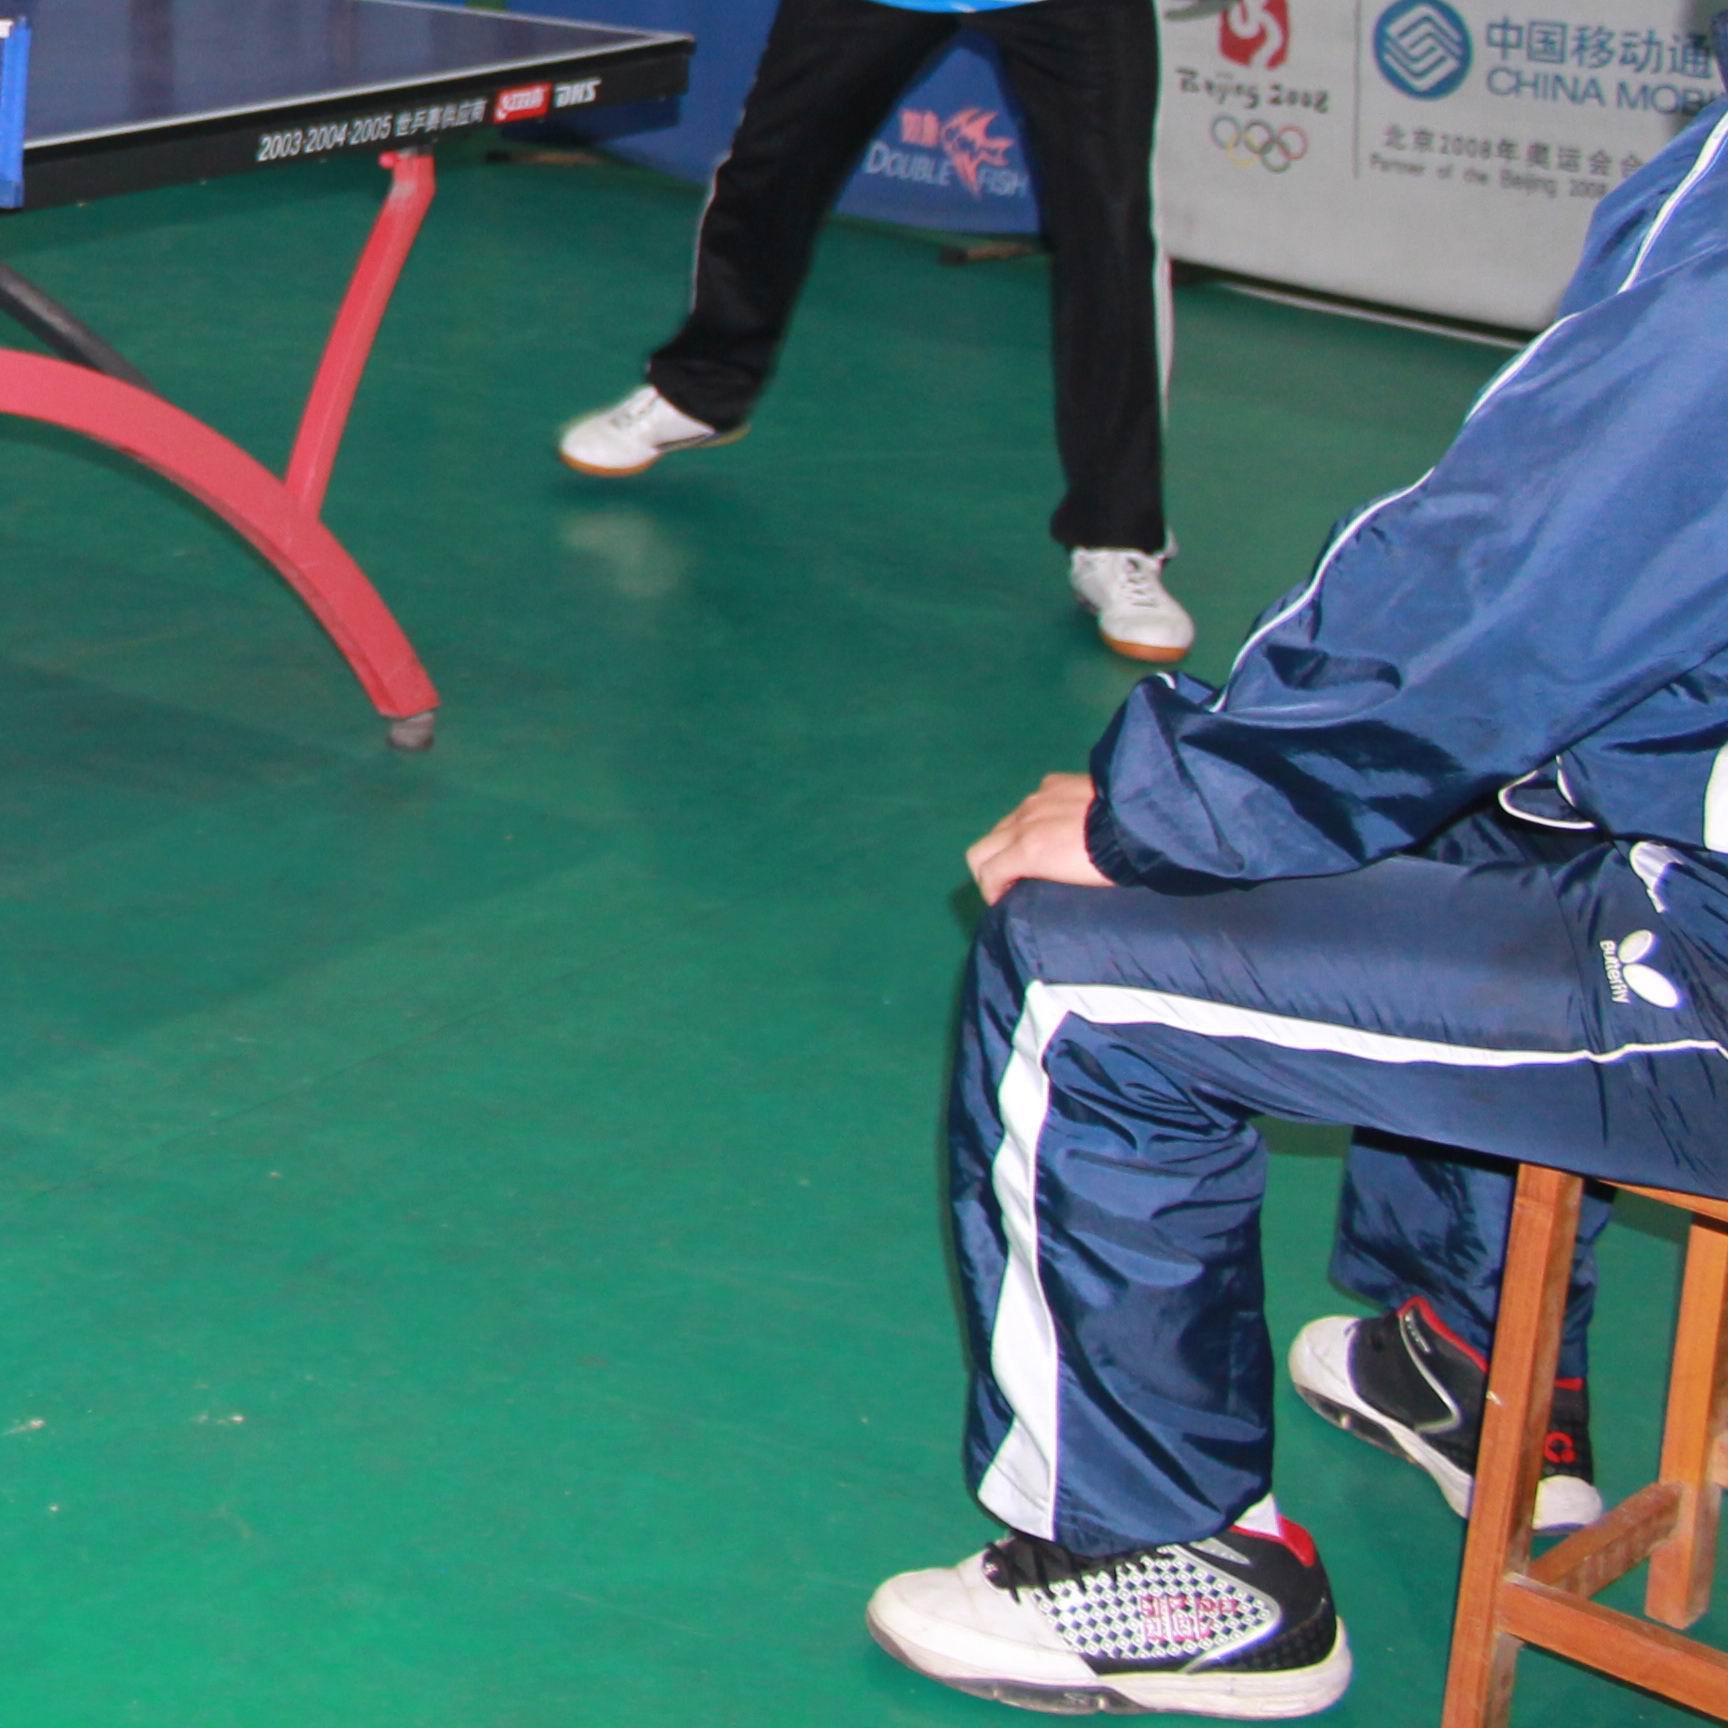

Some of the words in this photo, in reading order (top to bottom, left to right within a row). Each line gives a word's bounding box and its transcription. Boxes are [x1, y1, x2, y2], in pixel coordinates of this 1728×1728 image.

[554, 77, 602, 109] DHS
[1487, 67, 1607, 106] CHINA
[1599, 939, 1631, 1004] Butterfly
